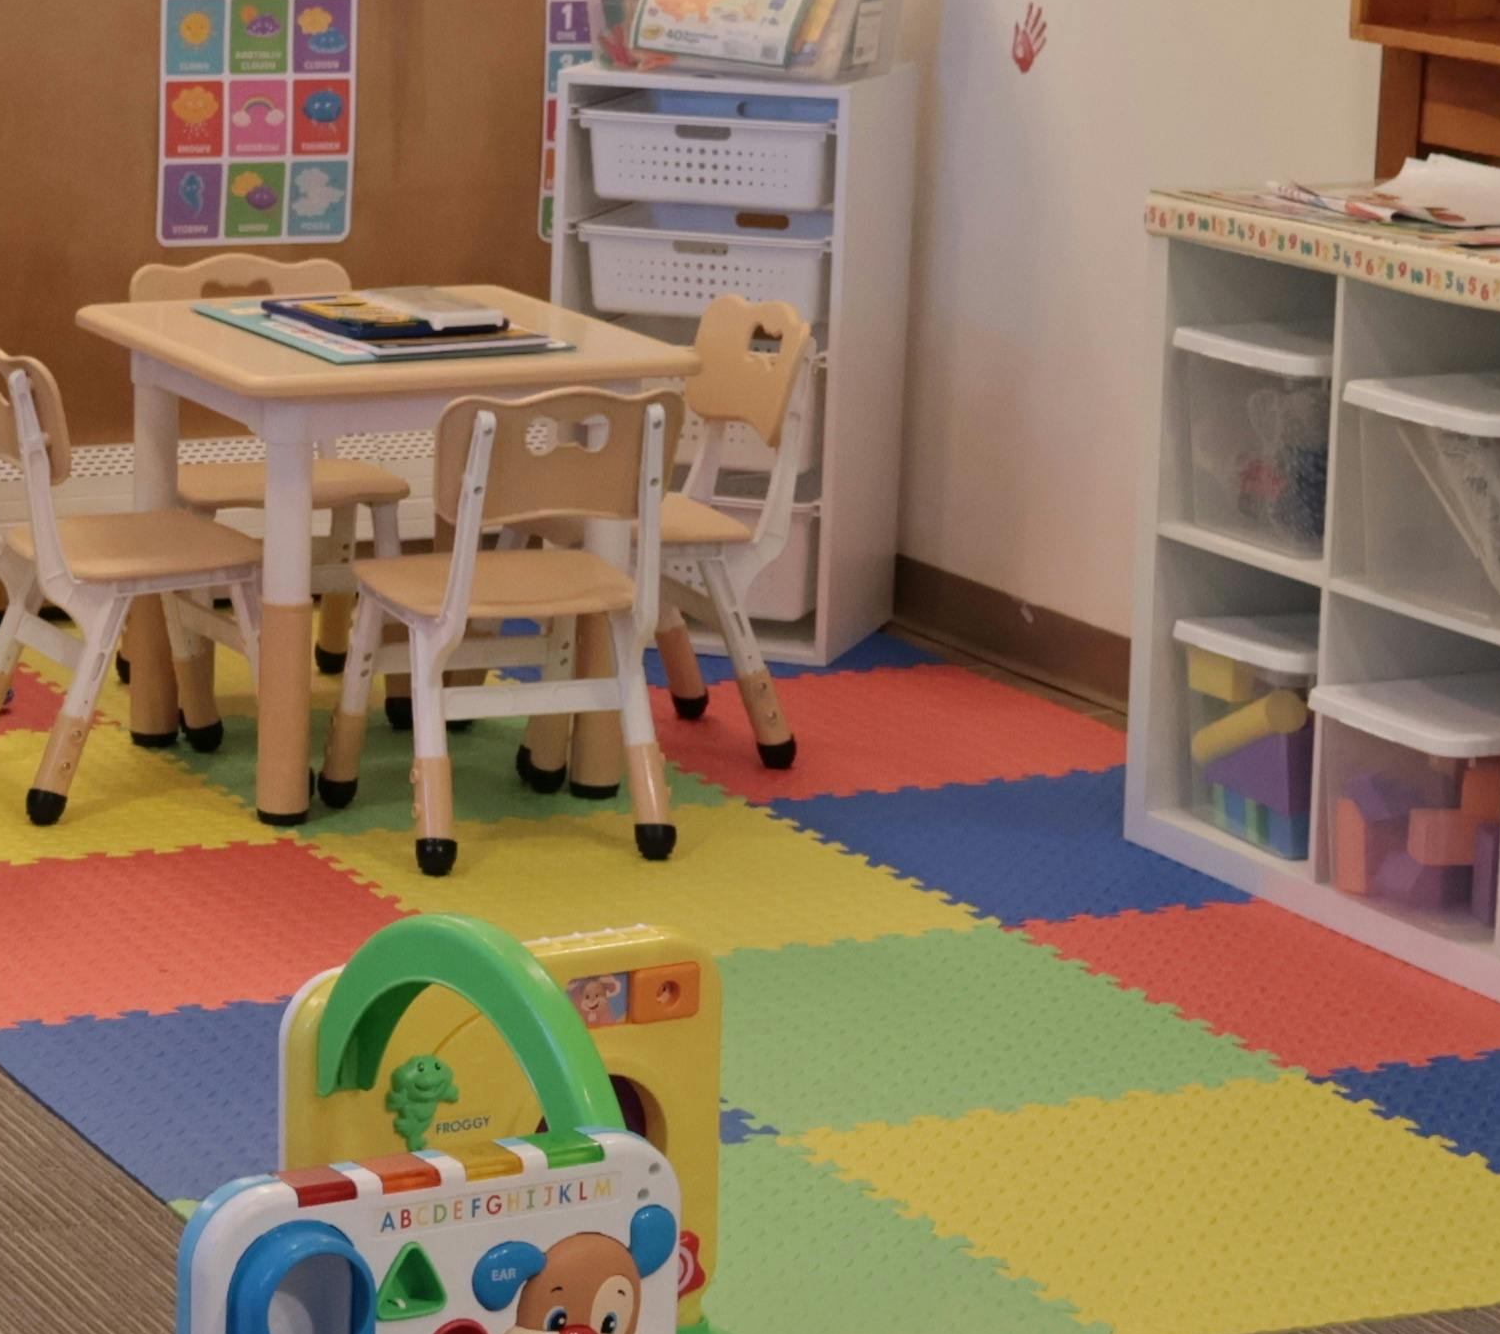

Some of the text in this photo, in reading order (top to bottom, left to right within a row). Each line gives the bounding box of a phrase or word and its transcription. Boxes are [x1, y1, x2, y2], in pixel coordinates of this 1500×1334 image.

[561, 3, 574, 30] 1
[435, 1115, 492, 1135] FROGGY
[491, 1268, 517, 1282] EAR
